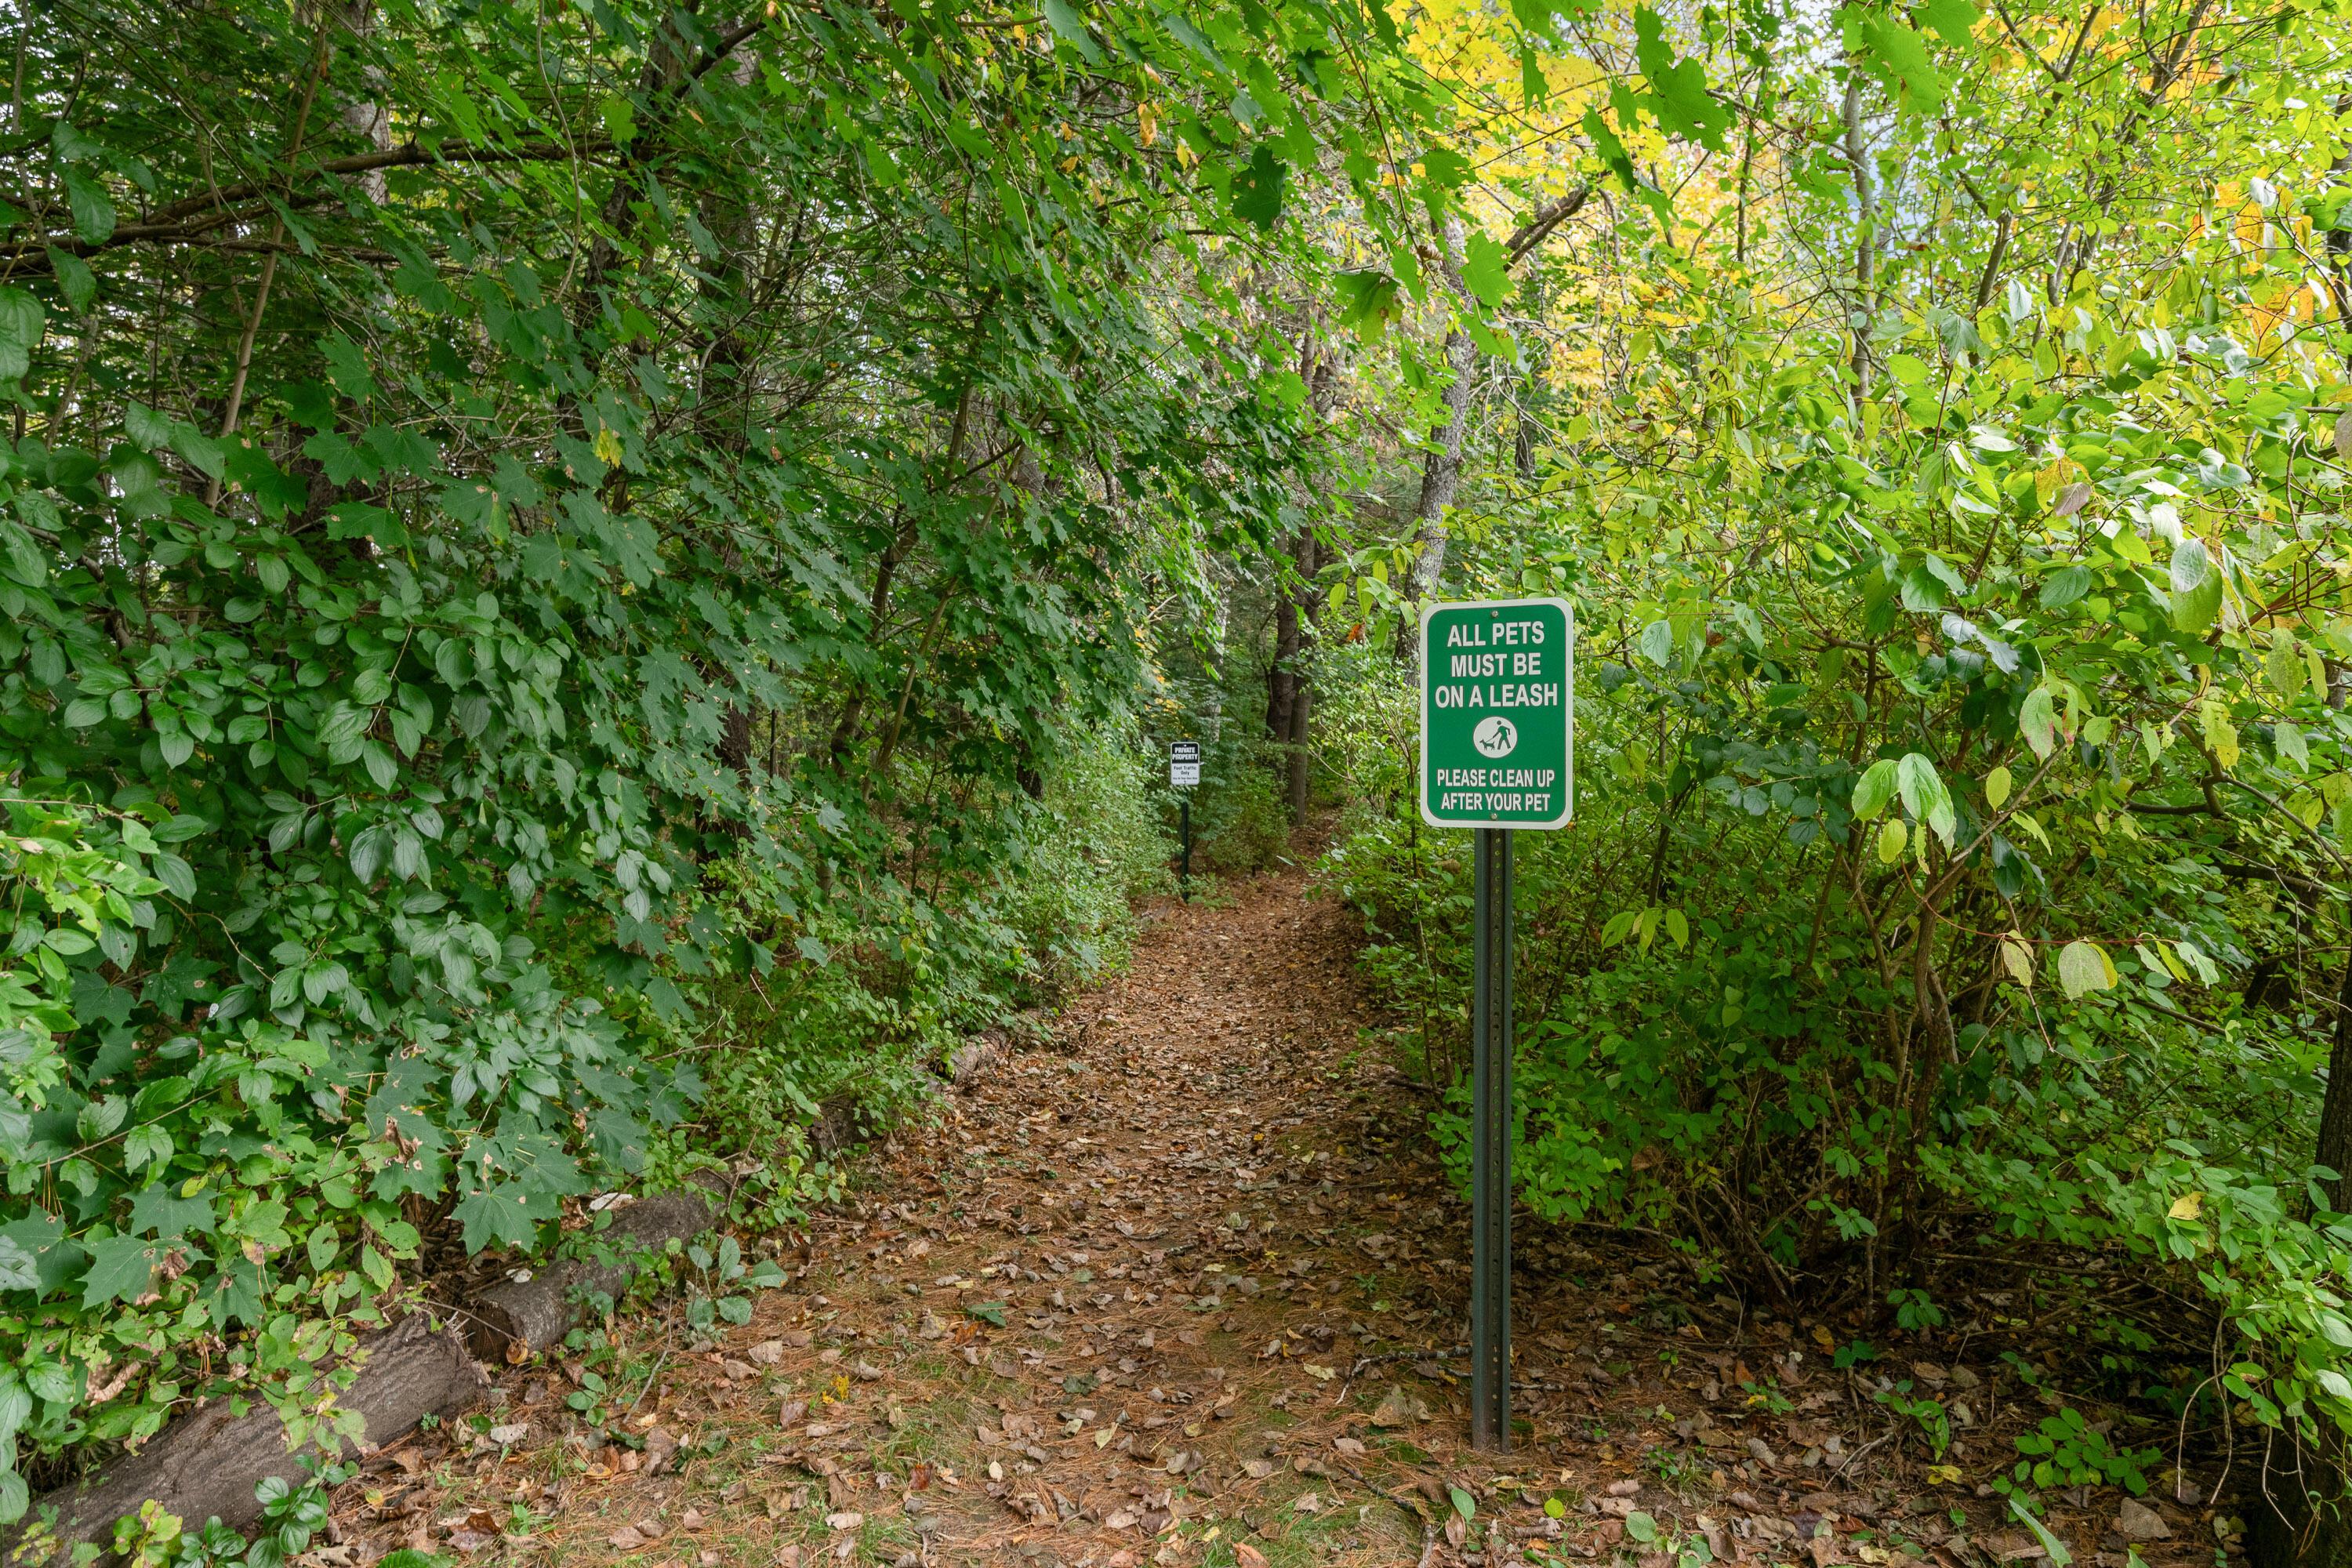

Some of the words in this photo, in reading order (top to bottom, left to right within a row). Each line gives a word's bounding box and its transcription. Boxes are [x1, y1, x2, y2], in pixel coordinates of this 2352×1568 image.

[1447, 625, 1486, 647] ALL
[1492, 621, 1544, 645] PETS
[1451, 653, 1507, 677] MUST
[1513, 652, 1541, 676] BE
[1435, 685, 1463, 708] ON
[1468, 684, 1483, 707] A
[1490, 683, 1558, 706] LEASH
[1437, 769, 1486, 786] PLEASE
[1490, 770, 1533, 787] CLEAN
[1537, 770, 1555, 787] UP
[1441, 793, 1483, 810] AFTER
[1485, 793, 1521, 811] YOUR
[1525, 793, 1550, 811] PET
